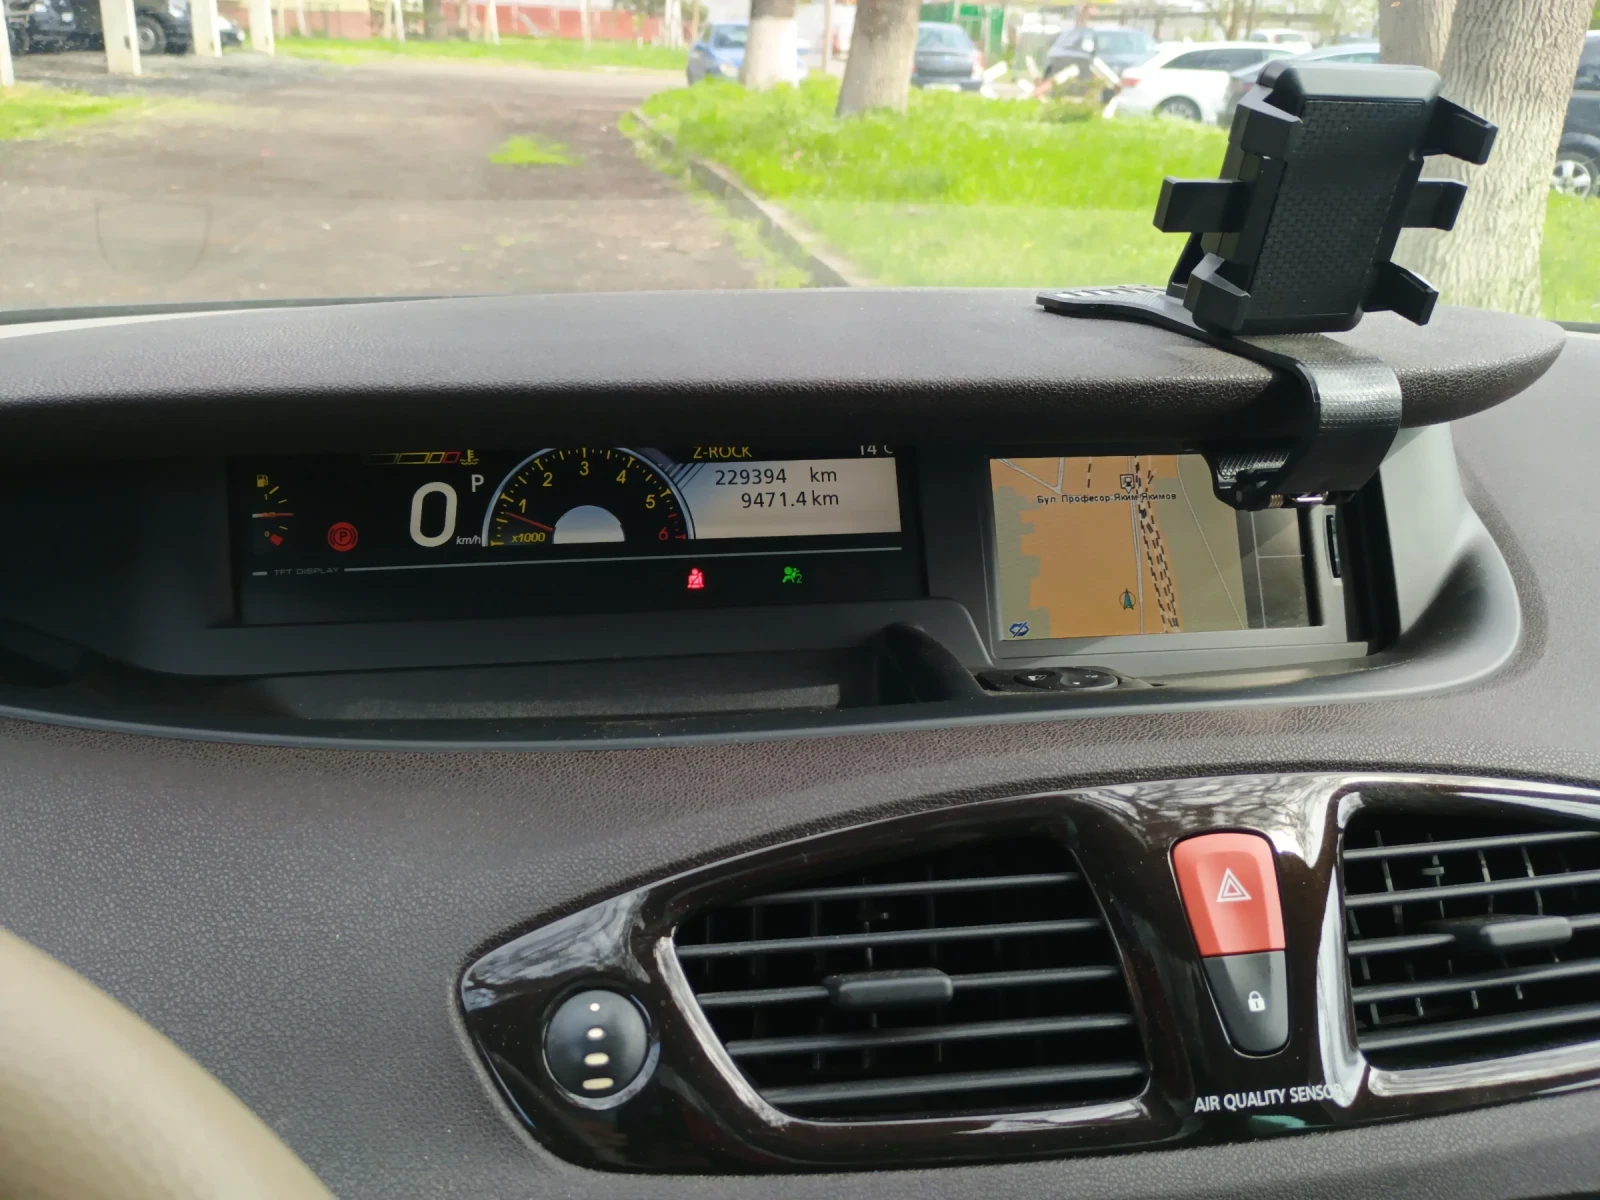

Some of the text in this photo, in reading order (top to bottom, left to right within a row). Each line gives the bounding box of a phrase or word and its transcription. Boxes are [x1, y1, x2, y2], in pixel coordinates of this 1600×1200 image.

[693, 446, 752, 459] Z-ROCK
[580, 461, 590, 476] 3
[715, 466, 838, 485] 229394 km
[471, 474, 485, 493] P
[542, 472, 553, 487] 2
[616, 469, 627, 484] 4
[518, 499, 527, 513] 1
[645, 494, 656, 509] 5
[741, 490, 840, 508] 9471.4 km
[1061, 494, 1111, 505] Професор
[1141, 492, 1177, 501] Якимов
[409, 481, 458, 548] 0
[456, 535, 482, 545] km/h
[512, 532, 546, 543] x1000
[658, 526, 669, 540] 6
[274, 567, 339, 576] TFT DISPLAY
[1194, 1096, 1221, 1113] AIR
[1223, 1088, 1286, 1112] QUALITY
